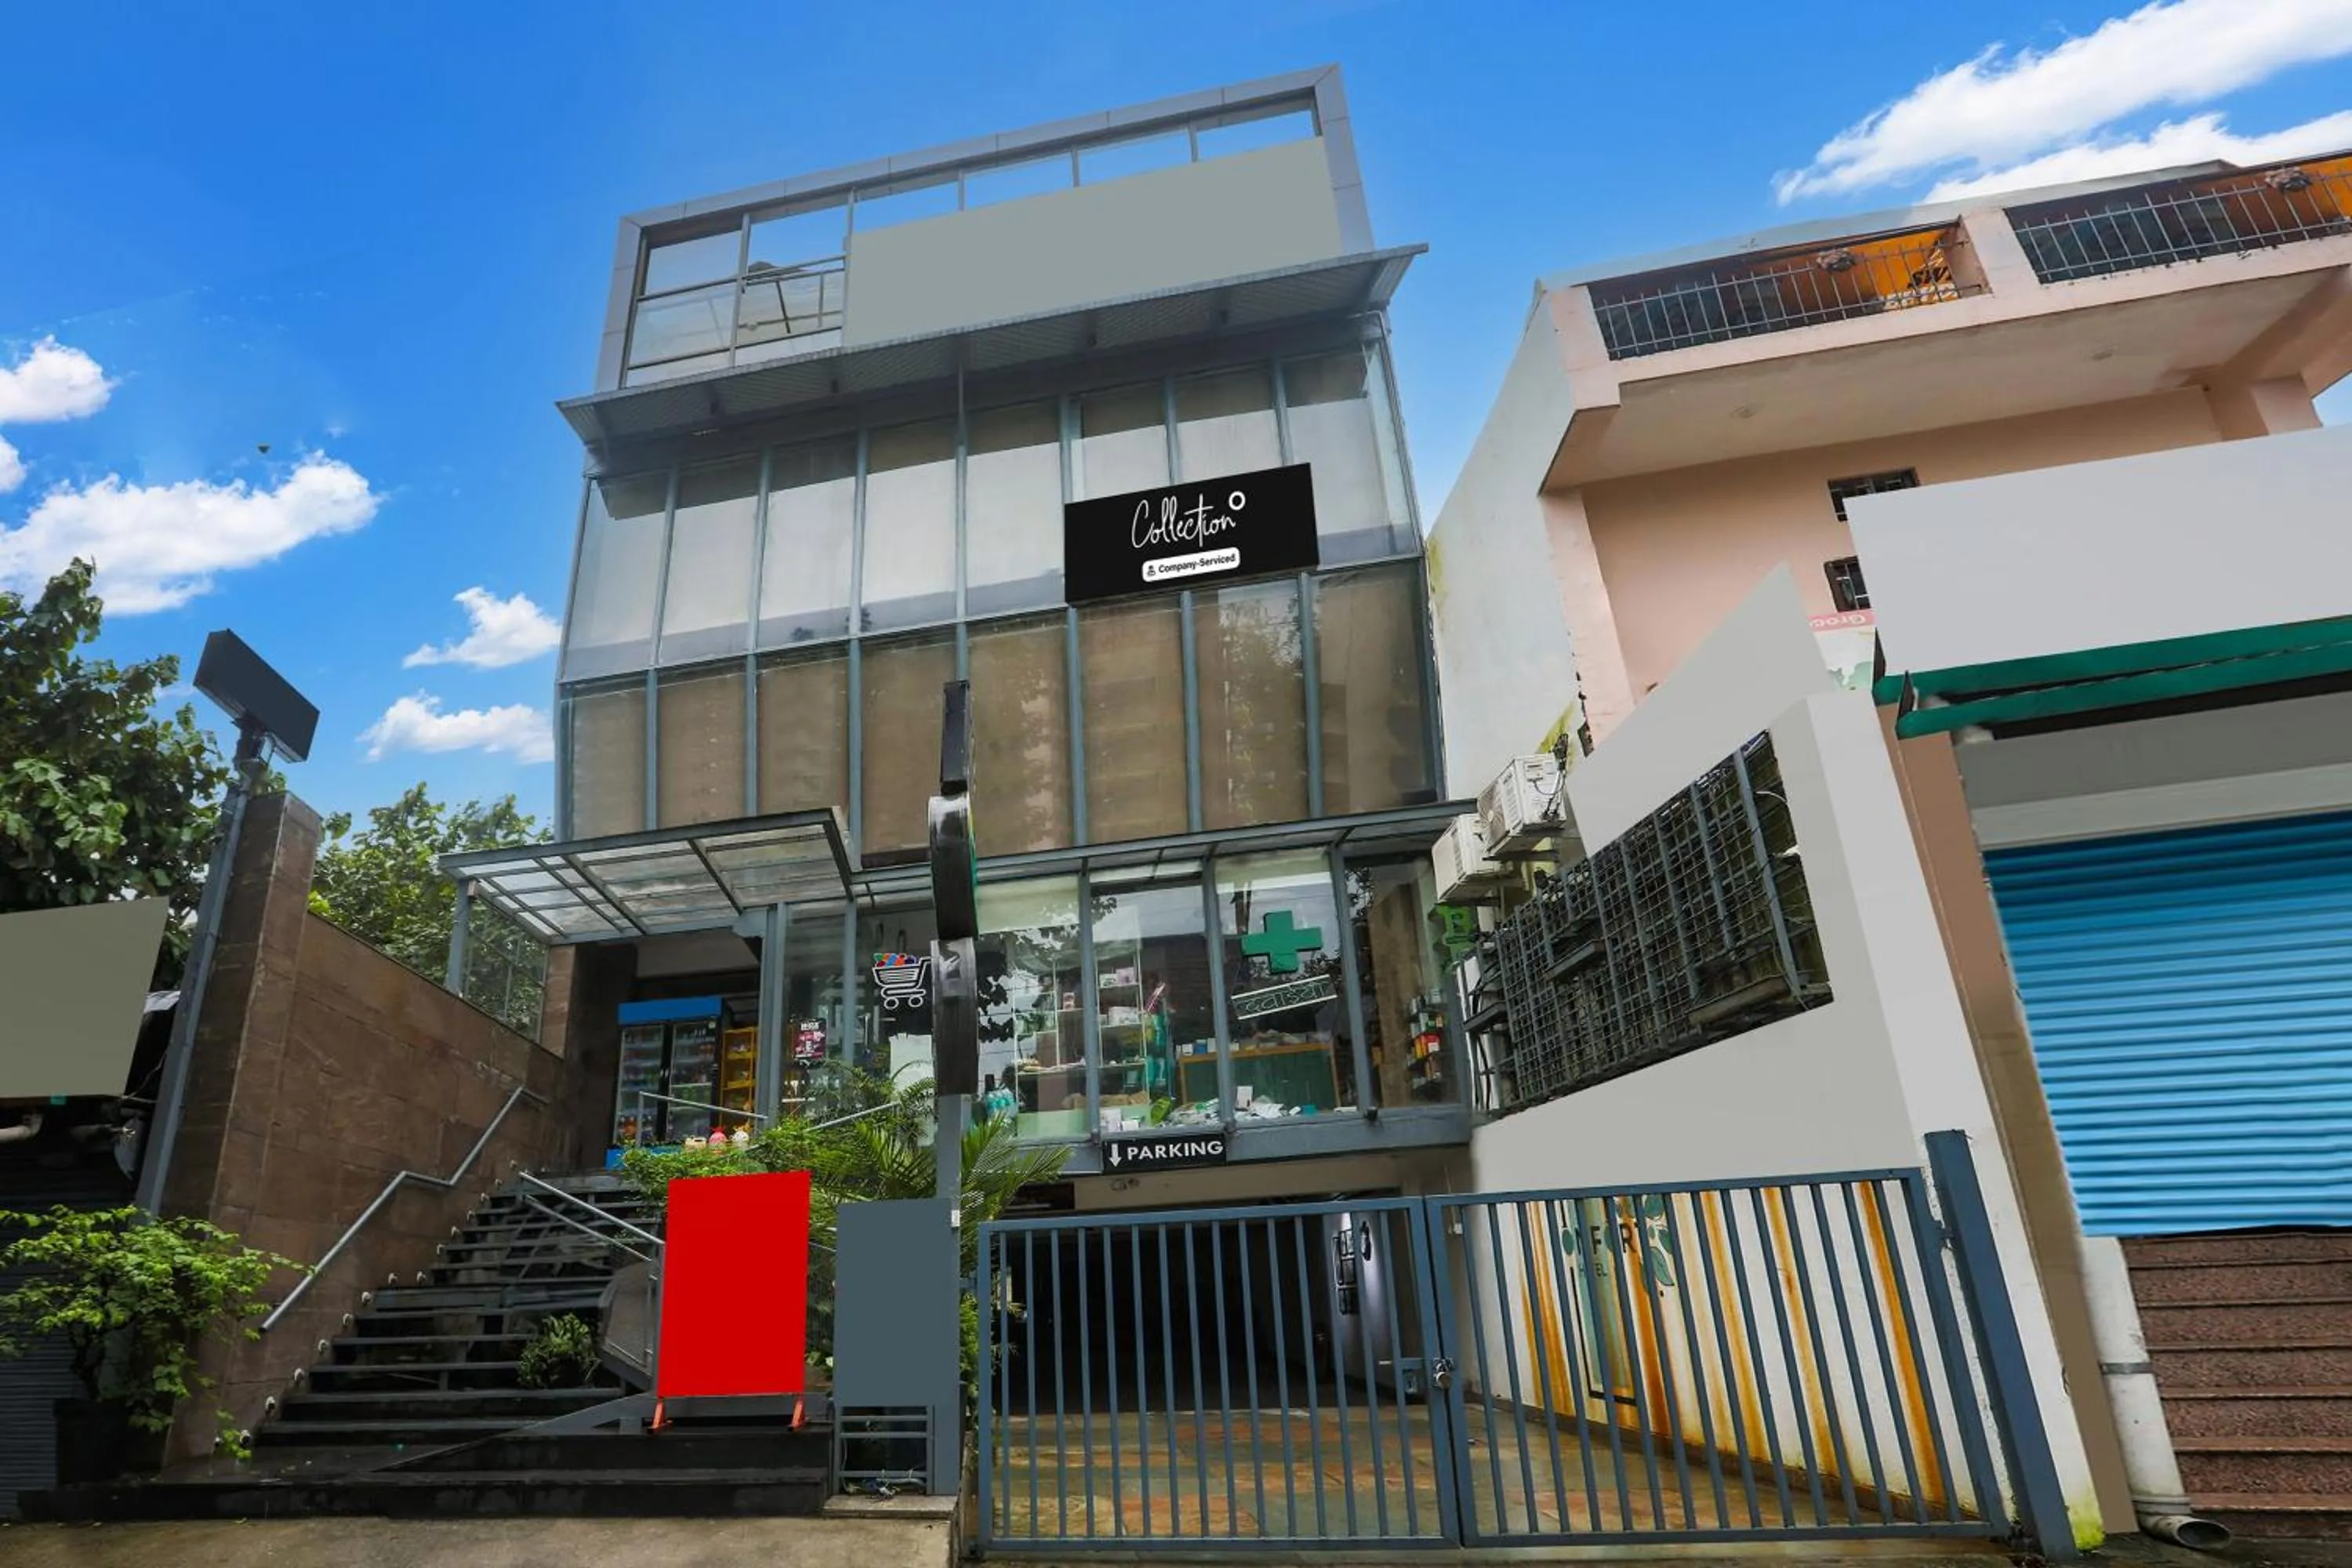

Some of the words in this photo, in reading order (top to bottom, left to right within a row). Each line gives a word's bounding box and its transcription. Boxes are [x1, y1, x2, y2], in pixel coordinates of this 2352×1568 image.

[1131, 492, 1236, 548] Collection
[1158, 553, 1236, 573] Company-Serviced
[1127, 1141, 1224, 1160] PARKING
